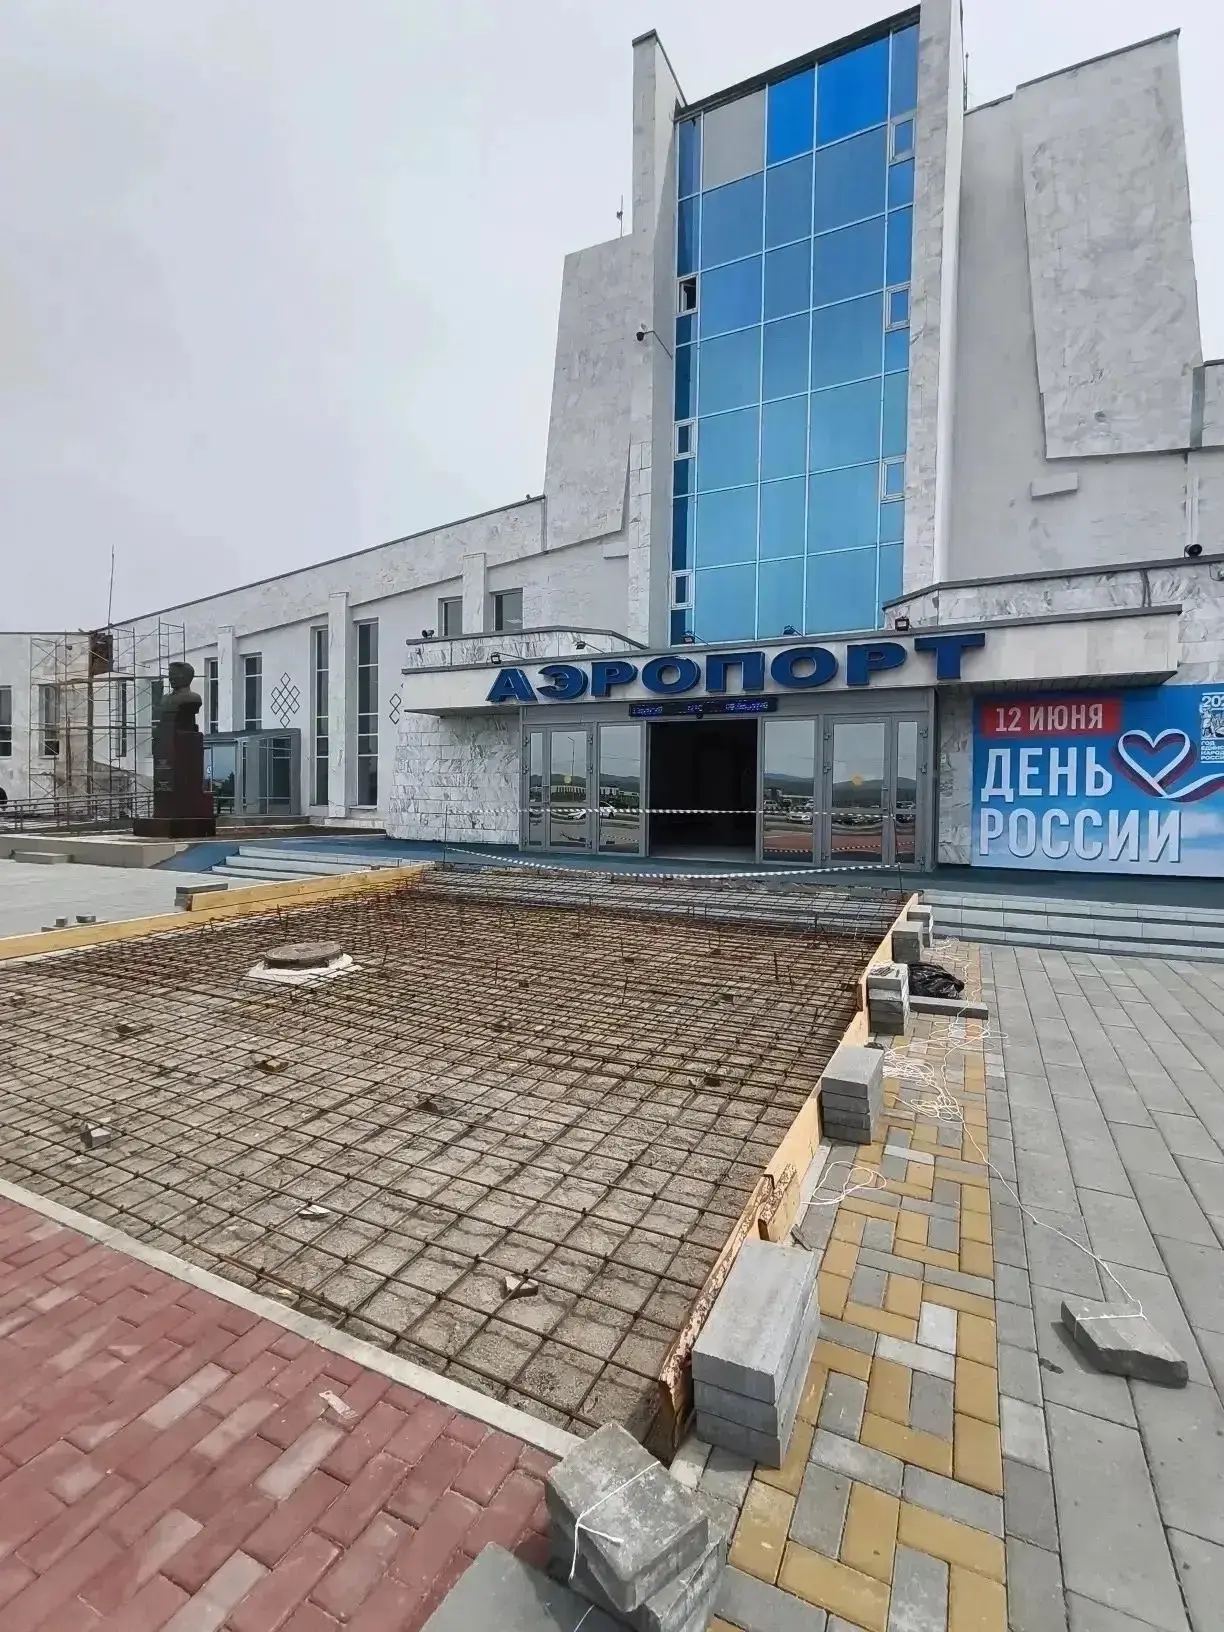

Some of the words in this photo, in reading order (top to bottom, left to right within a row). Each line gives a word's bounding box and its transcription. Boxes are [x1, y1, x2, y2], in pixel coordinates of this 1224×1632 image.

[485, 632, 986, 705] АЭРОПОРТ
[995, 706, 1022, 732] 12
[1029, 703, 1104, 731] ИЮНЯ
[980, 746, 1113, 803] ДЕНЬ
[979, 808, 1182, 863] РОССИИ
